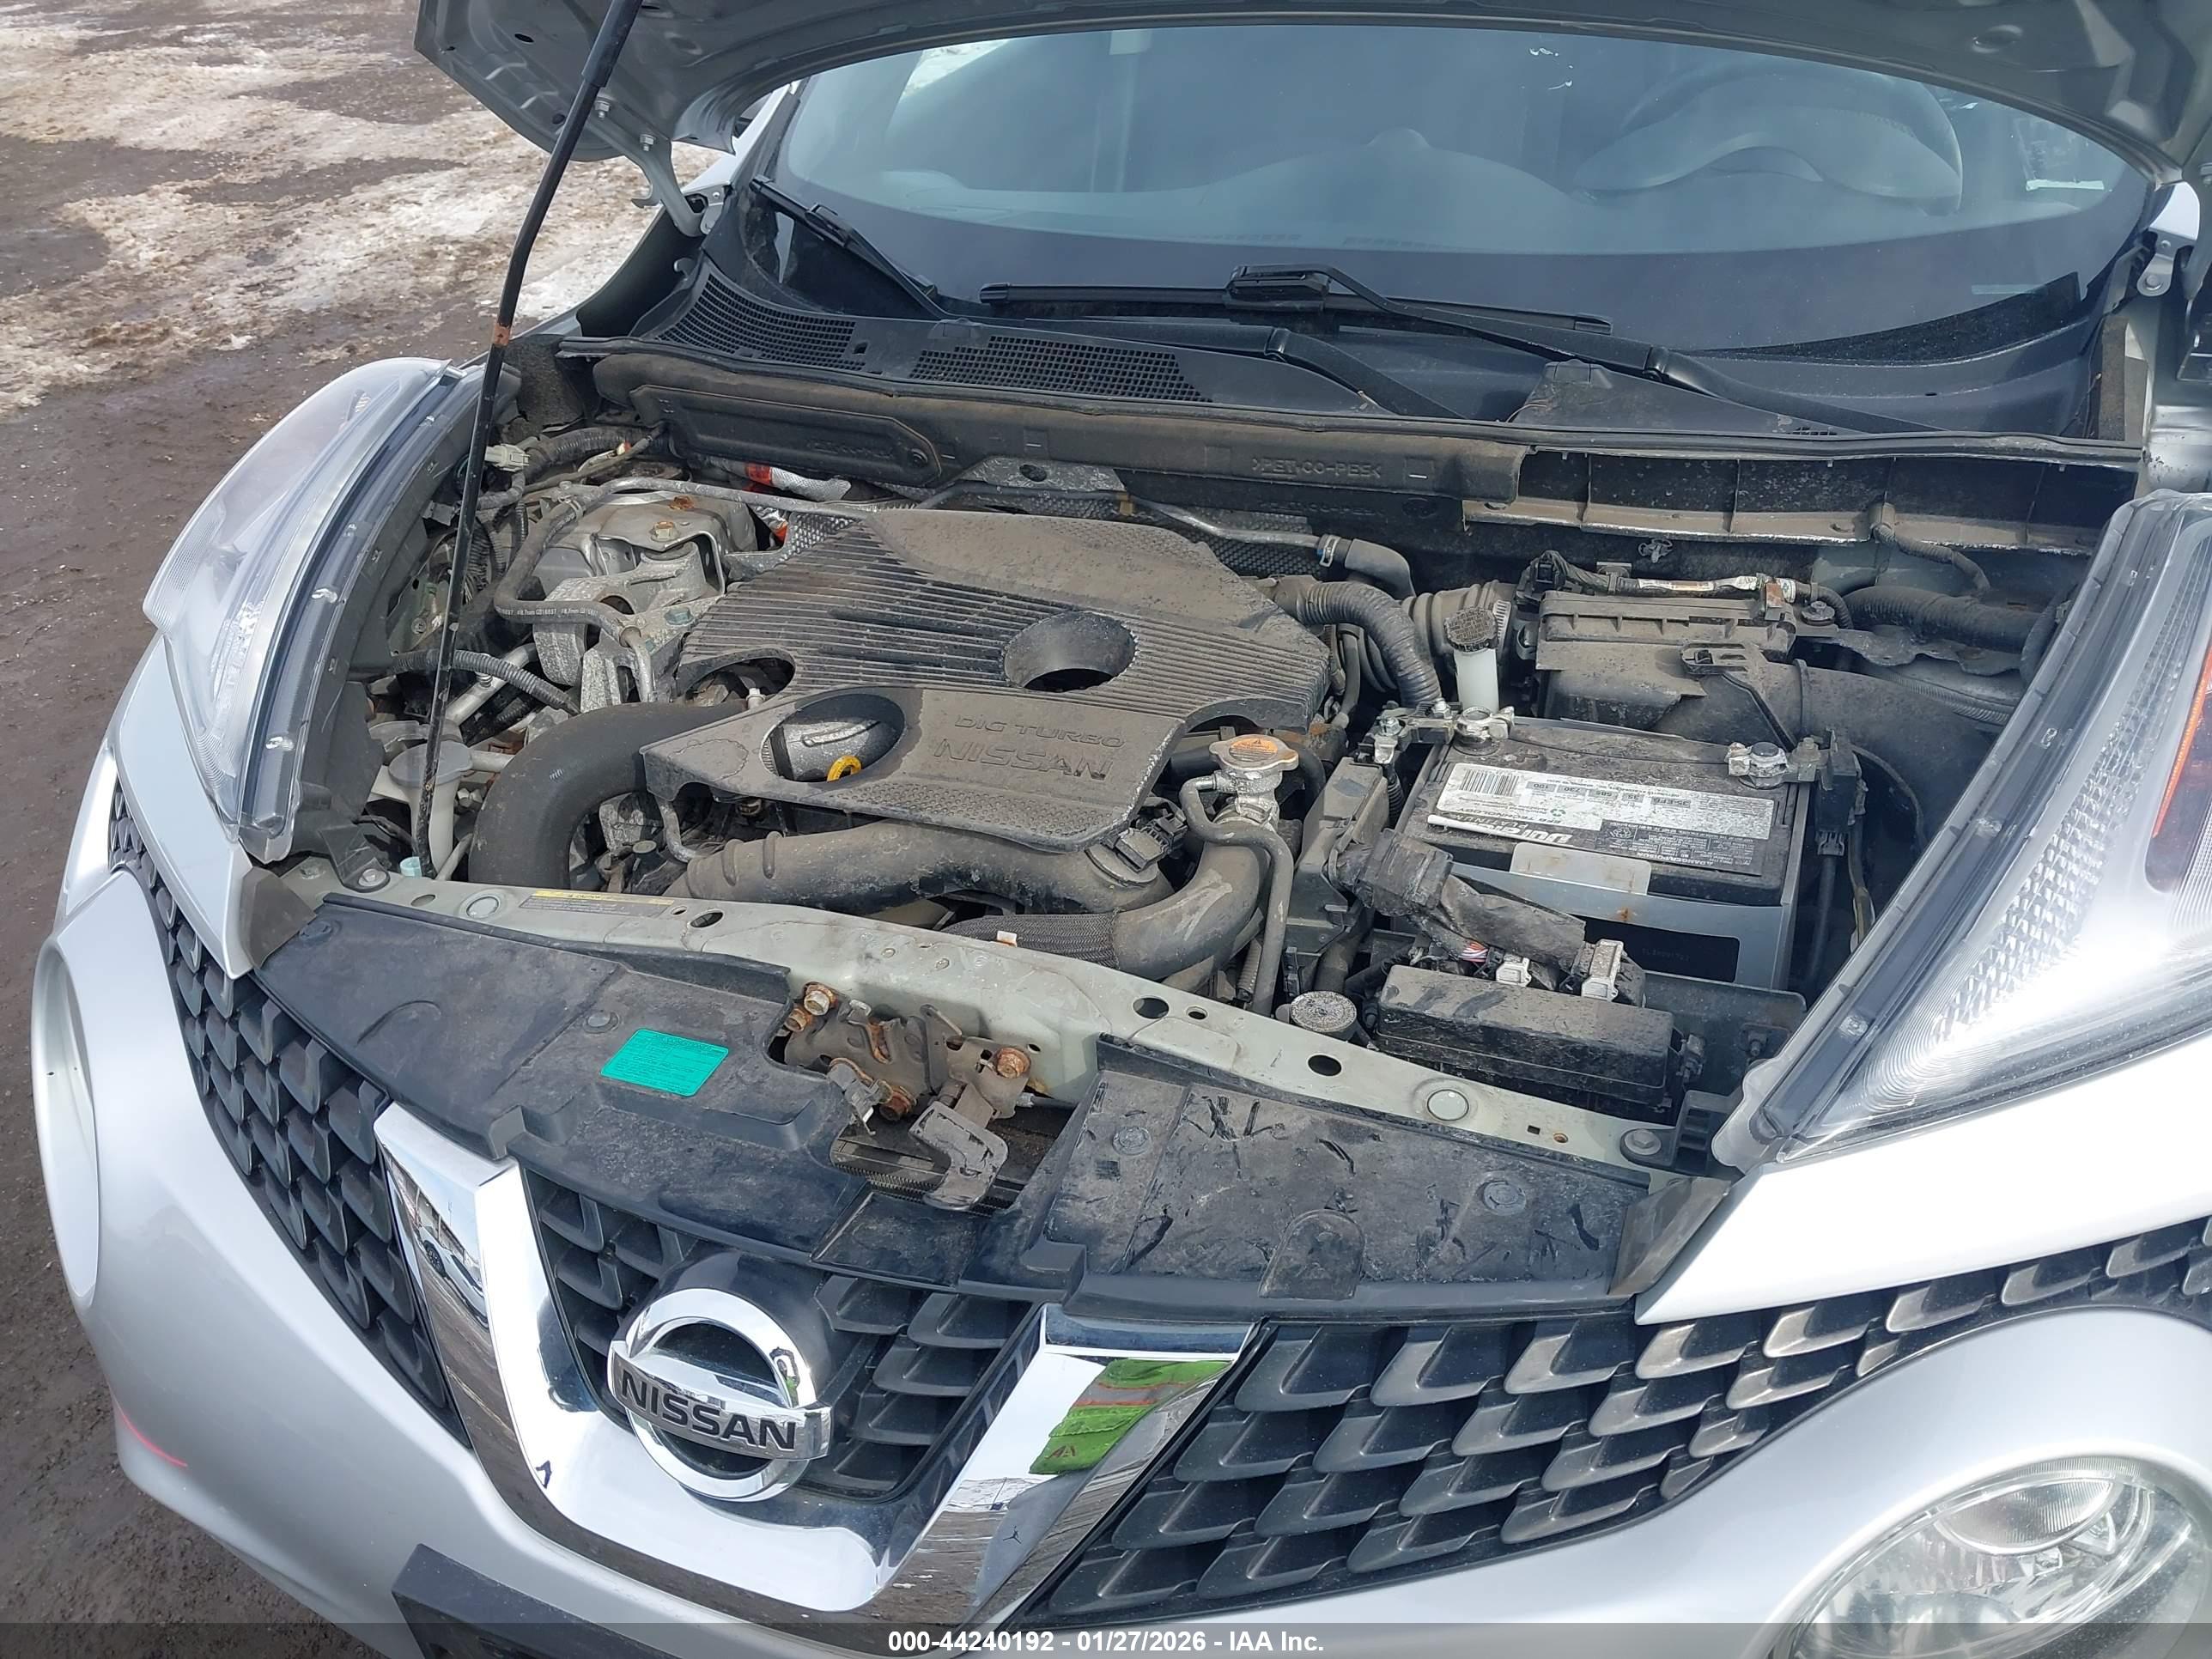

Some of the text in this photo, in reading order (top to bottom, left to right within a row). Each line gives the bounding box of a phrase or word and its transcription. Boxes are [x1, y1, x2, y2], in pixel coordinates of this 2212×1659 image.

[1016, 723, 1127, 748] TURBO
[934, 738, 1113, 781] NISSAN
[1453, 813, 1528, 829] PLATINUM
[620, 1370, 796, 1450] NISSAN
